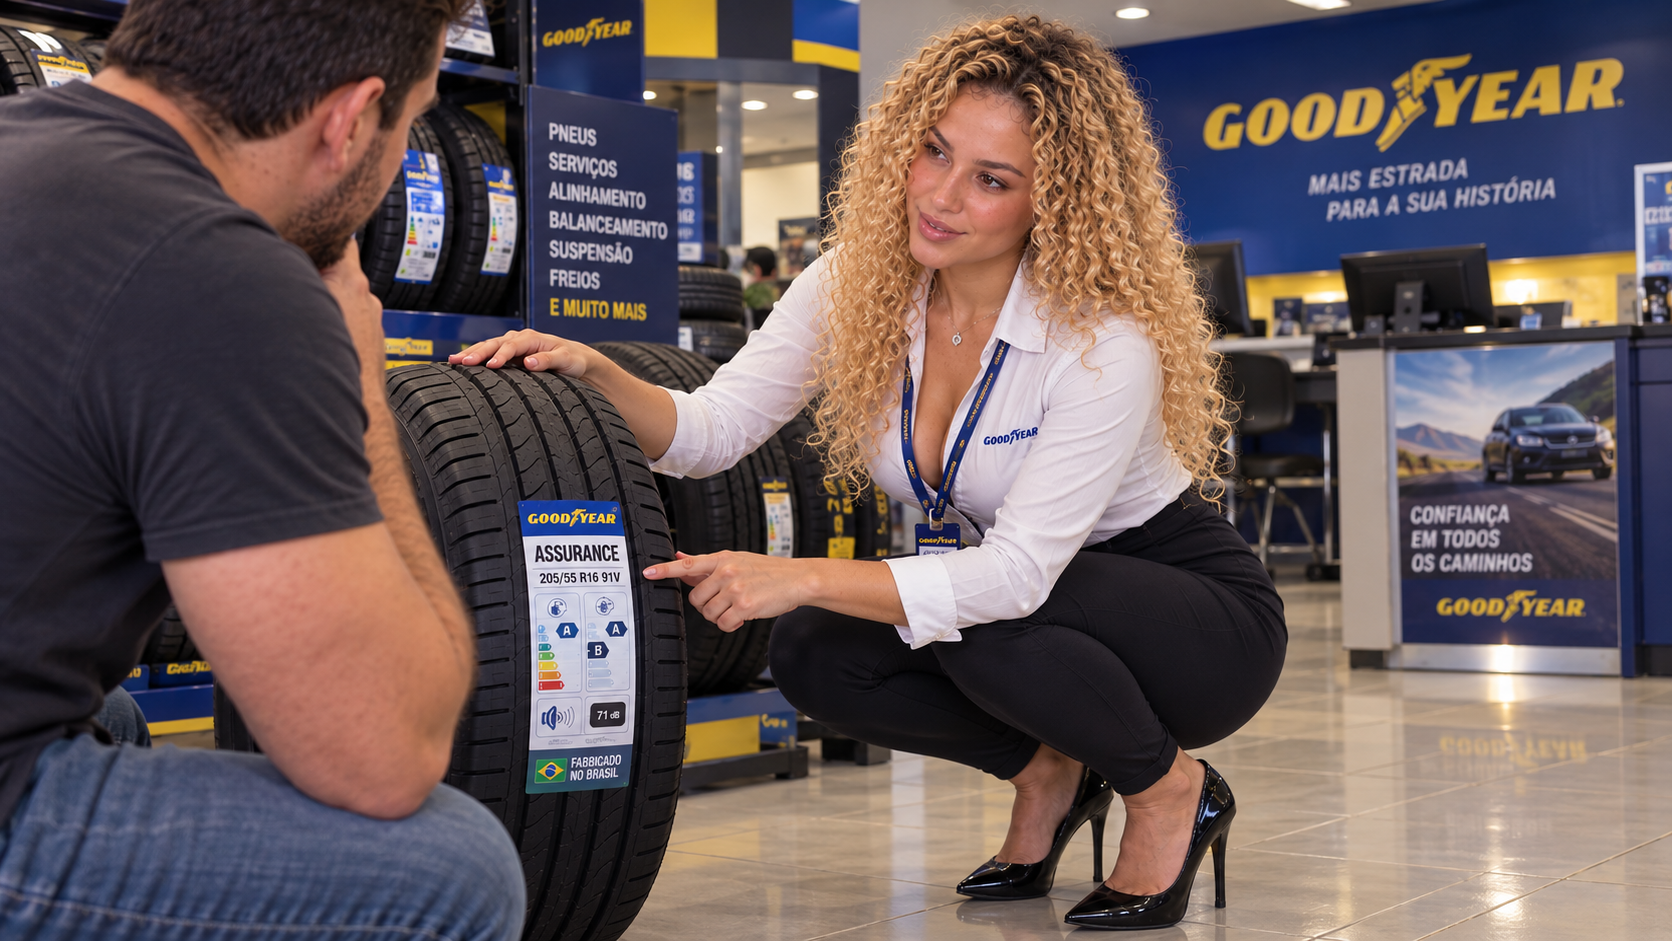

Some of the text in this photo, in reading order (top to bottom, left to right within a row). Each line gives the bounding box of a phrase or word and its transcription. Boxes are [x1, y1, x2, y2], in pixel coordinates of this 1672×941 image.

[542, 17, 632, 47] GOODYEAR
[1203, 54, 1624, 152] GOODYEAR
[549, 122, 597, 147] PNEUS
[549, 152, 618, 179] SERVIÇOS
[1308, 157, 1468, 196] MAIS ESTRADA
[549, 181, 646, 210] ALINHAMENTO
[1326, 176, 1556, 222] PARA A SUA HISTÓRIA
[549, 210, 668, 240] BALANCEAMENTO
[549, 239, 633, 265] SUSPENSÃO
[549, 269, 601, 290] FREIOS
[550, 298, 647, 321] E MUITO MAIS
[984, 427, 1038, 446] GOODYEAR
[527, 508, 617, 527] GOODYEAR
[1410, 504, 1510, 528] CONFIANÇA
[1411, 529, 1501, 549] EM TODOS
[535, 544, 620, 563] ASSURANCE
[1411, 552, 1533, 573] OS CAMINHOS
[539, 571, 621, 585] 205/55 R16 91V
[1436, 590, 1586, 623] GOODYEAR
[563, 625, 572, 636] A
[612, 623, 621, 635] A
[594, 645, 603, 656] B
[596, 710, 609, 721] 71
[569, 767, 619, 782] NO BRASIL
